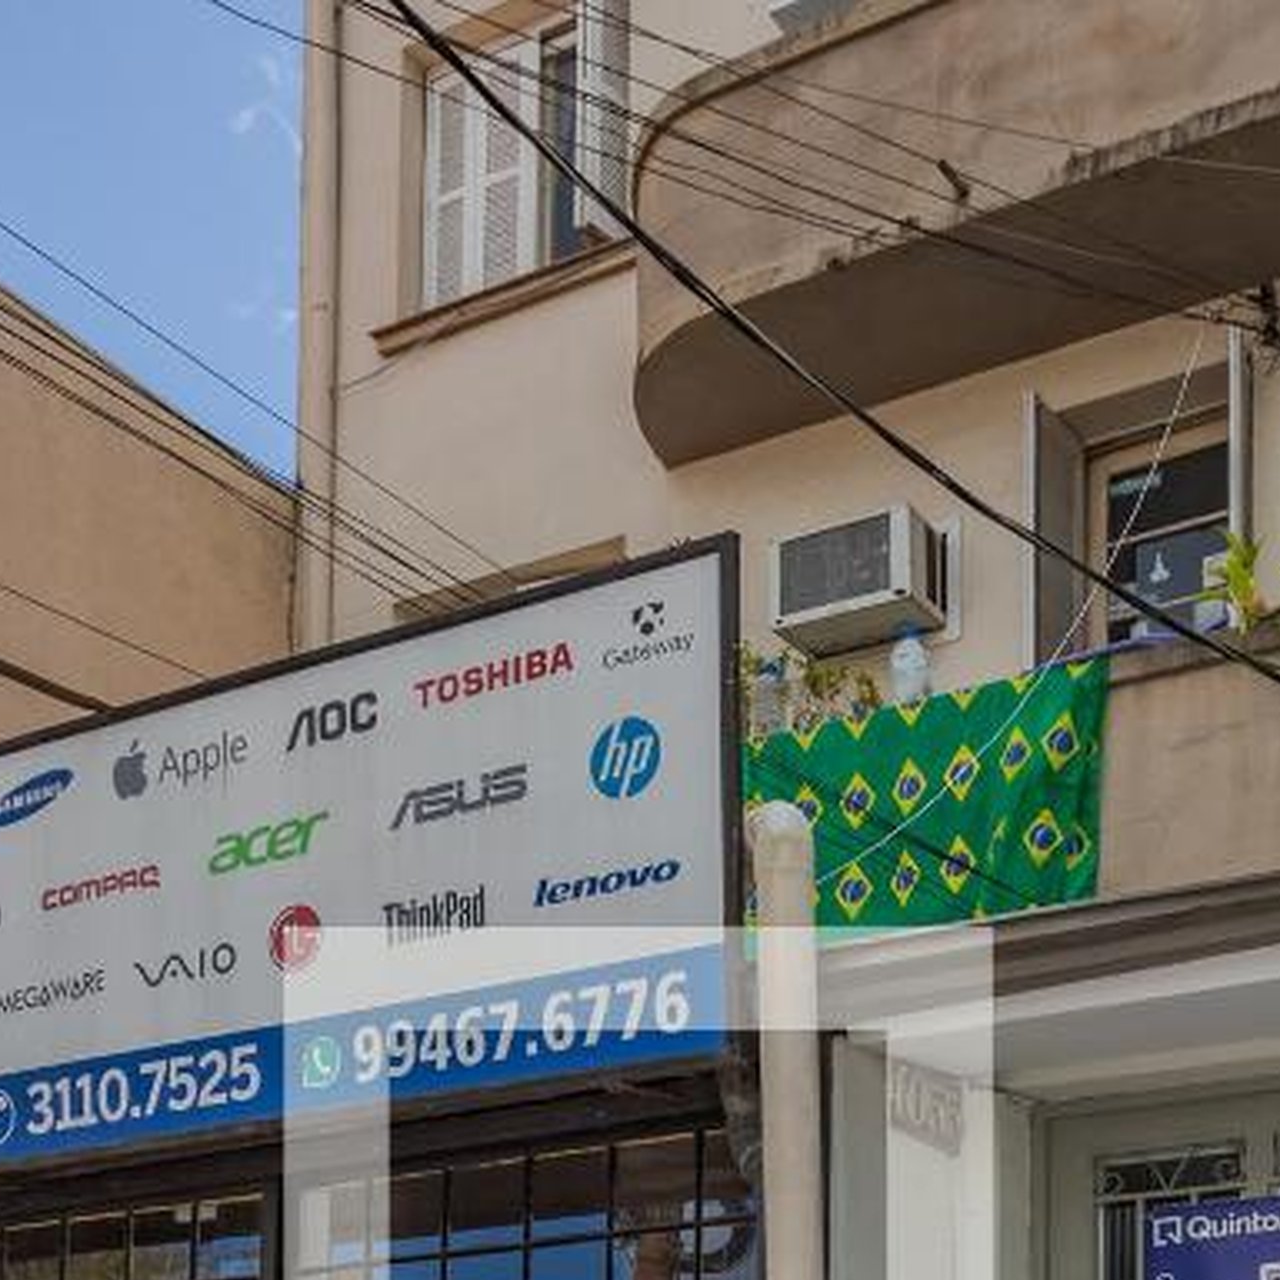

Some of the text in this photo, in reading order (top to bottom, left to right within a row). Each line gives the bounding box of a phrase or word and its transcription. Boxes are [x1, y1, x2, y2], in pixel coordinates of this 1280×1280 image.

[413, 641, 574, 709] TOSHIBA
[287, 691, 379, 752] AOC
[158, 730, 249, 787] Apple
[600, 717, 652, 798] hp
[389, 763, 528, 830] ASUS
[208, 809, 330, 875] acer
[41, 864, 161, 911] COMPAQ
[382, 884, 486, 946] ThinkPad
[533, 858, 681, 908] lenovo
[133, 942, 237, 988] VAIO
[352, 970, 690, 1083] 99467.6776
[26, 1043, 262, 1136] 3110.7525
